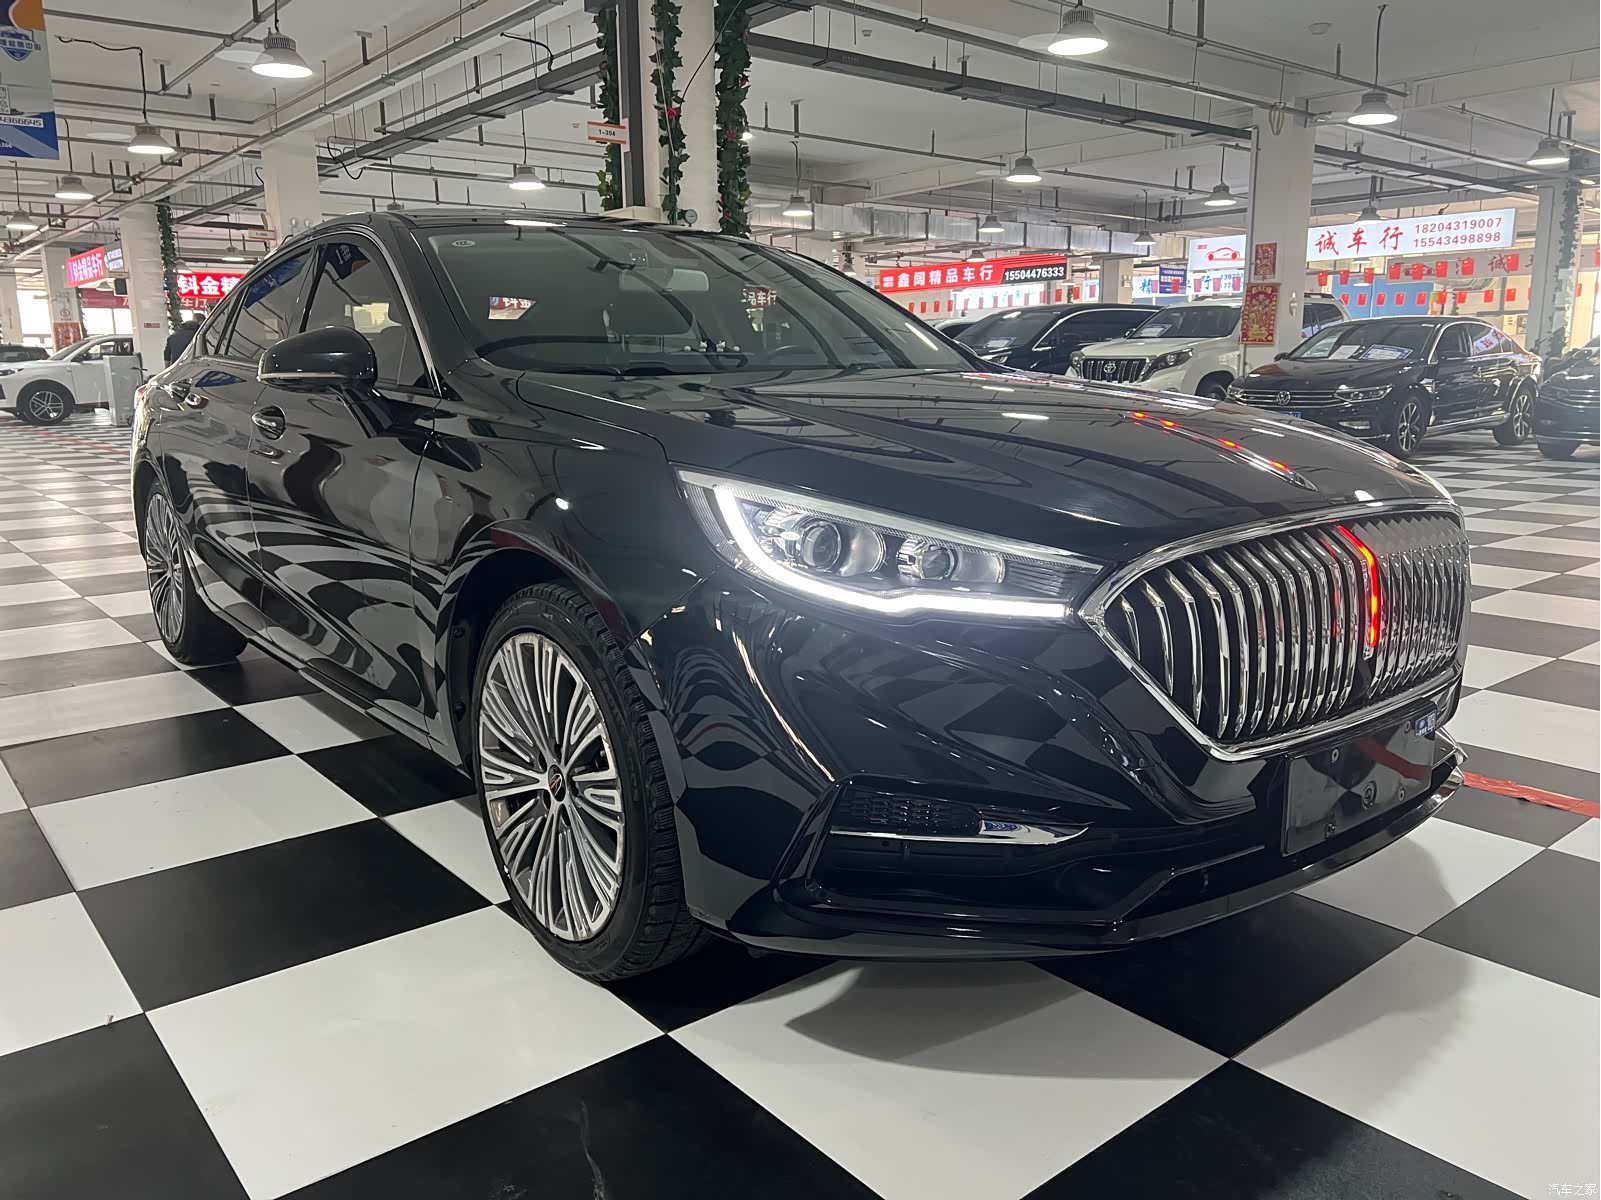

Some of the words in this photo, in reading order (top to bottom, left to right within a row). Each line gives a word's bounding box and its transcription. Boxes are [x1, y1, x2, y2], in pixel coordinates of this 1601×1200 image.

[1415, 217, 1503, 234] 18204319007
[1413, 231, 1501, 248] 15543498898
[897, 264, 994, 289] 鑫阔精品车行
[1004, 267, 1065, 281] 15504476333
